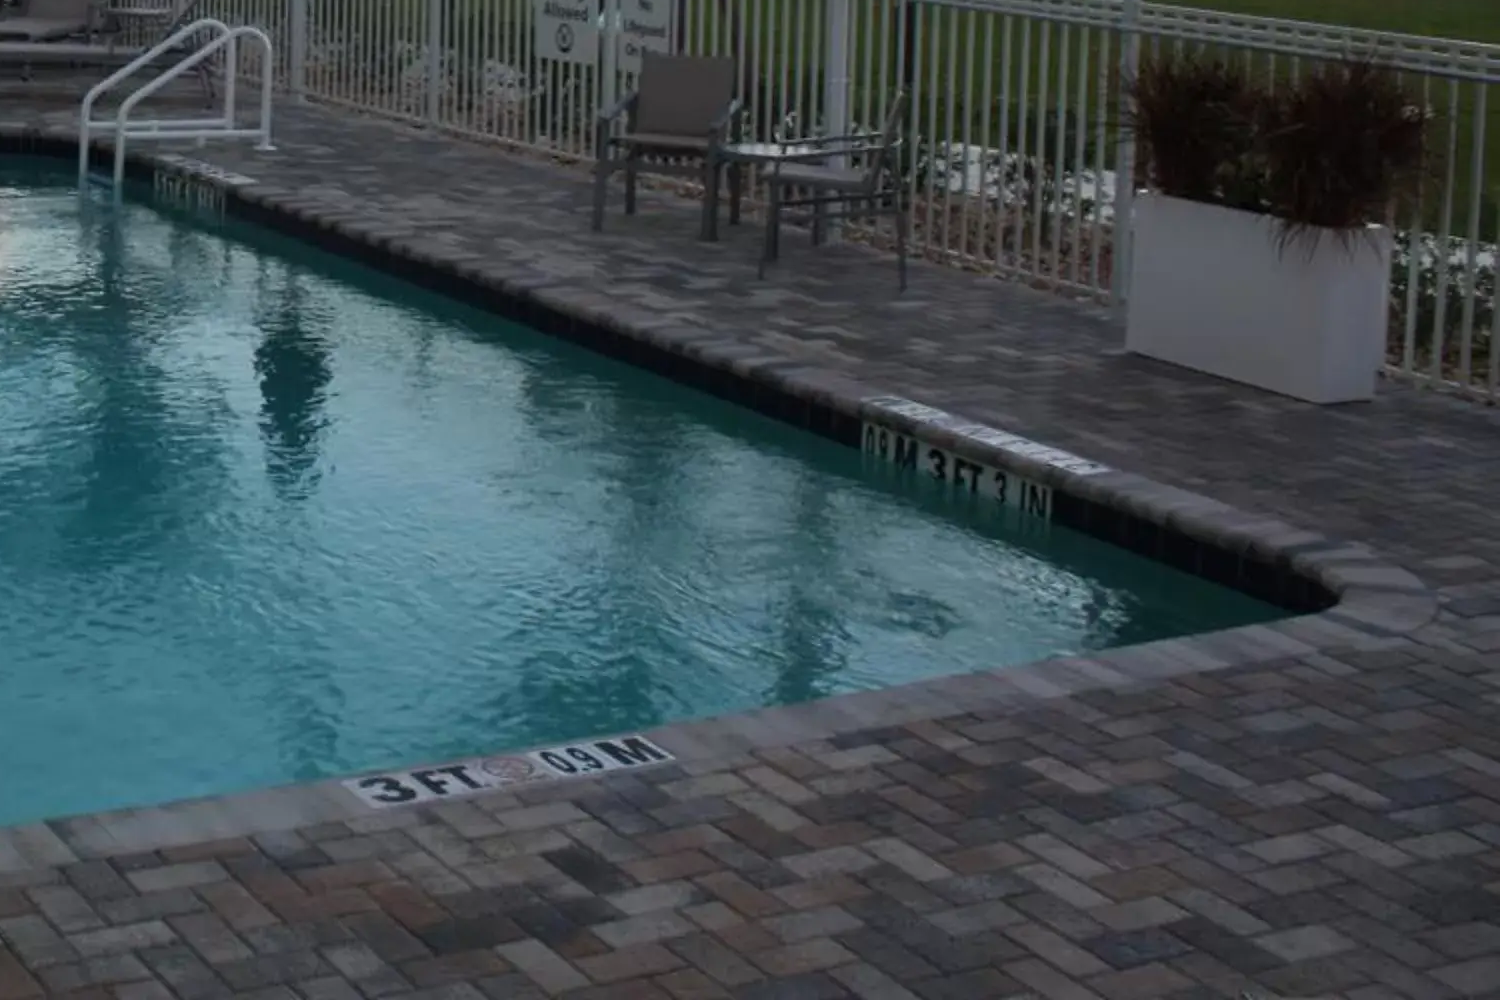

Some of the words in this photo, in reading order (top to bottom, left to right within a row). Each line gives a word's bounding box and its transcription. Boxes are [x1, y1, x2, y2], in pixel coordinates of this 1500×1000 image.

[543, 0, 588, 23] Allowed
[895, 435, 918, 470] M
[928, 448, 946, 481] 3
[954, 457, 984, 494] FT
[1020, 480, 1046, 519] IN
[357, 775, 418, 804] 3
[410, 764, 485, 796] FT
[595, 736, 668, 766] M
